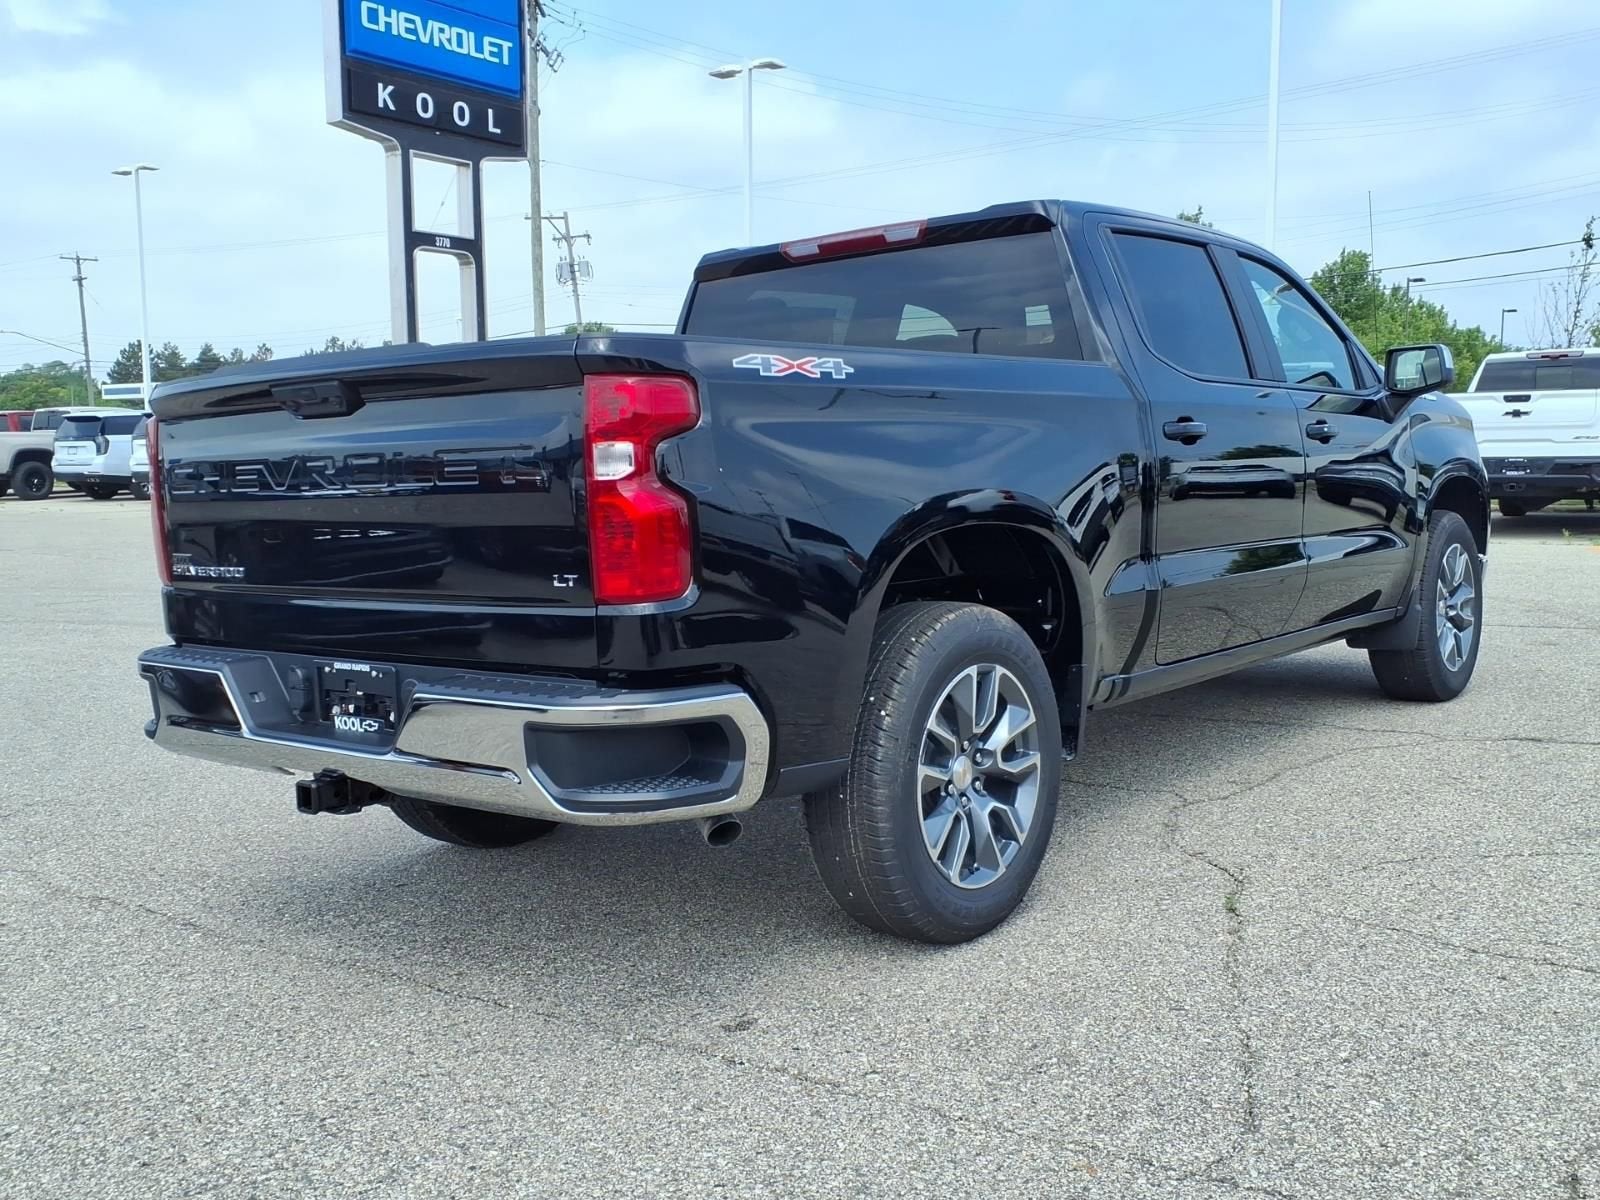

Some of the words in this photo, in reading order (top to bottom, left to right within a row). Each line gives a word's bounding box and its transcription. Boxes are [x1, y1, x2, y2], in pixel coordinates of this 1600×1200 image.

[361, 0, 513, 65] CHEVROLET
[377, 82, 502, 134] KOOL
[435, 236, 450, 248] 3770
[168, 446, 538, 495] CHEVROLET
[552, 574, 579, 587] LT
[334, 715, 365, 732] KOOL
